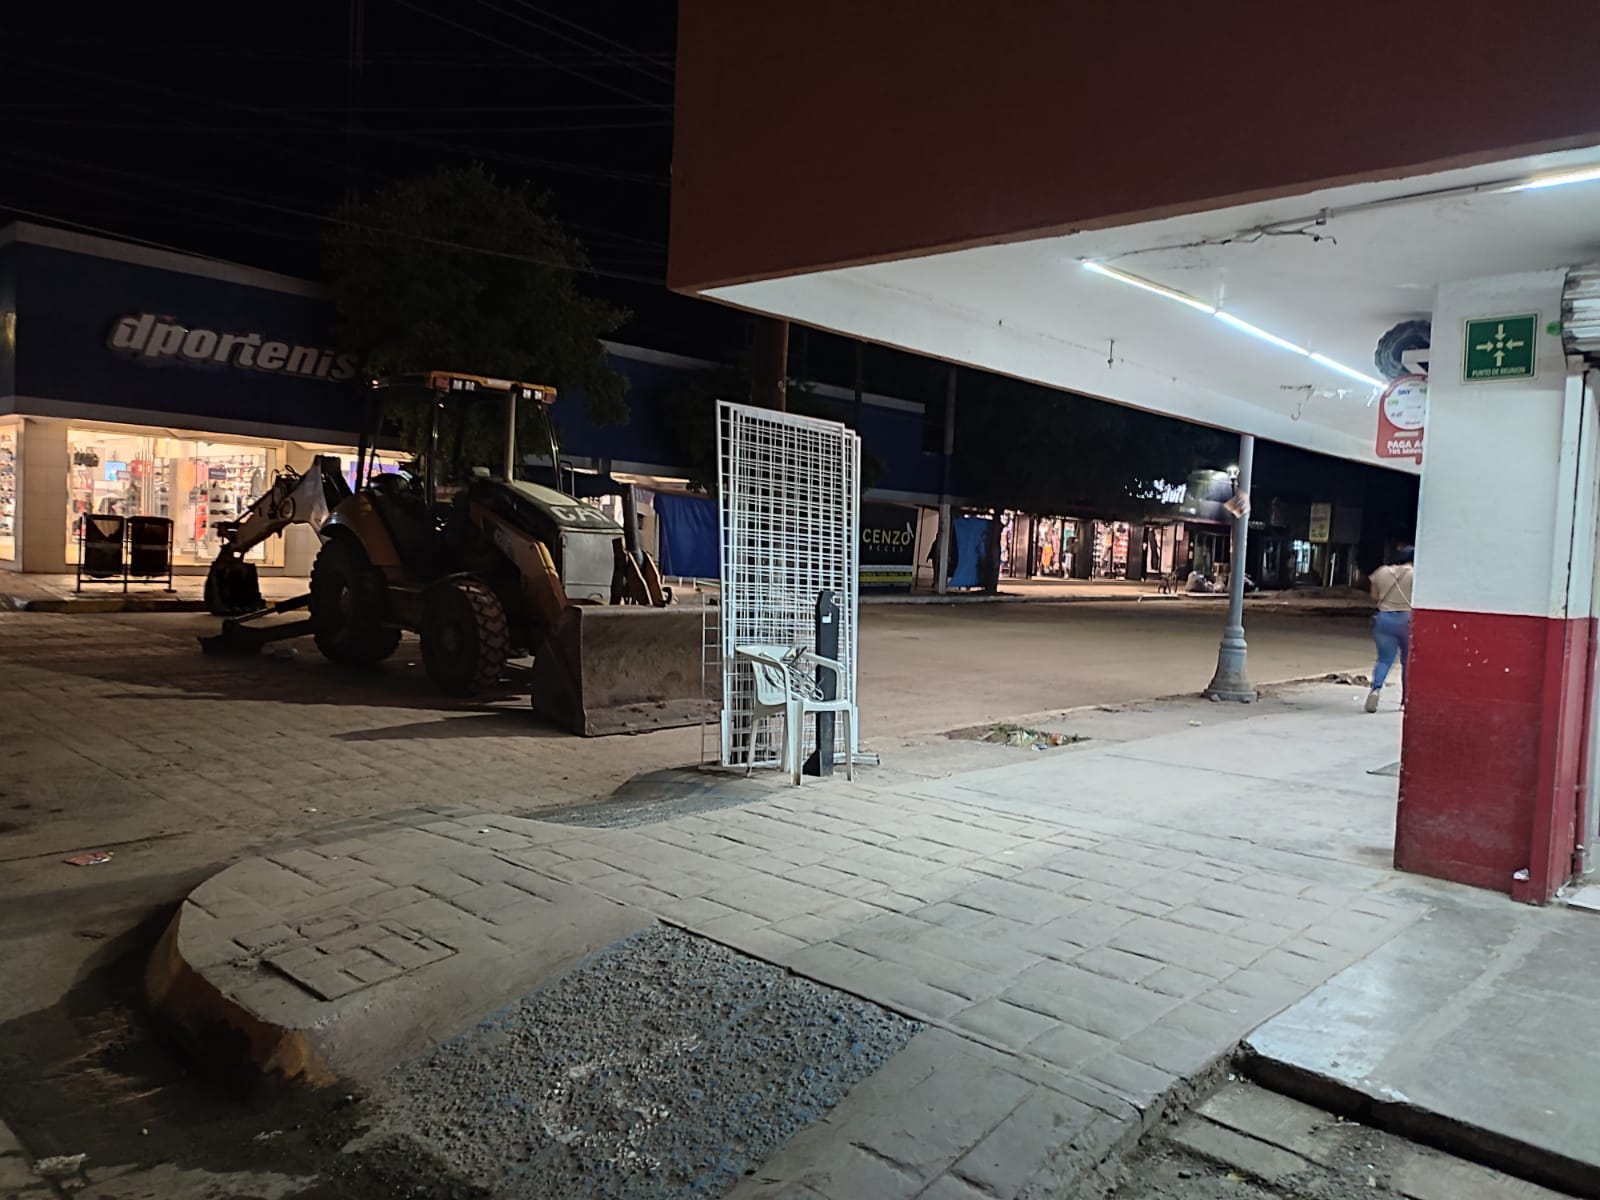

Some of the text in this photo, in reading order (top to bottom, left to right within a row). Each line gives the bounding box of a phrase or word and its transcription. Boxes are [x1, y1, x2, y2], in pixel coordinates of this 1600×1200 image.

[112, 313, 357, 380] dportenis
[1387, 440, 1412, 449] PAGA
[550, 506, 610, 522] CAT
